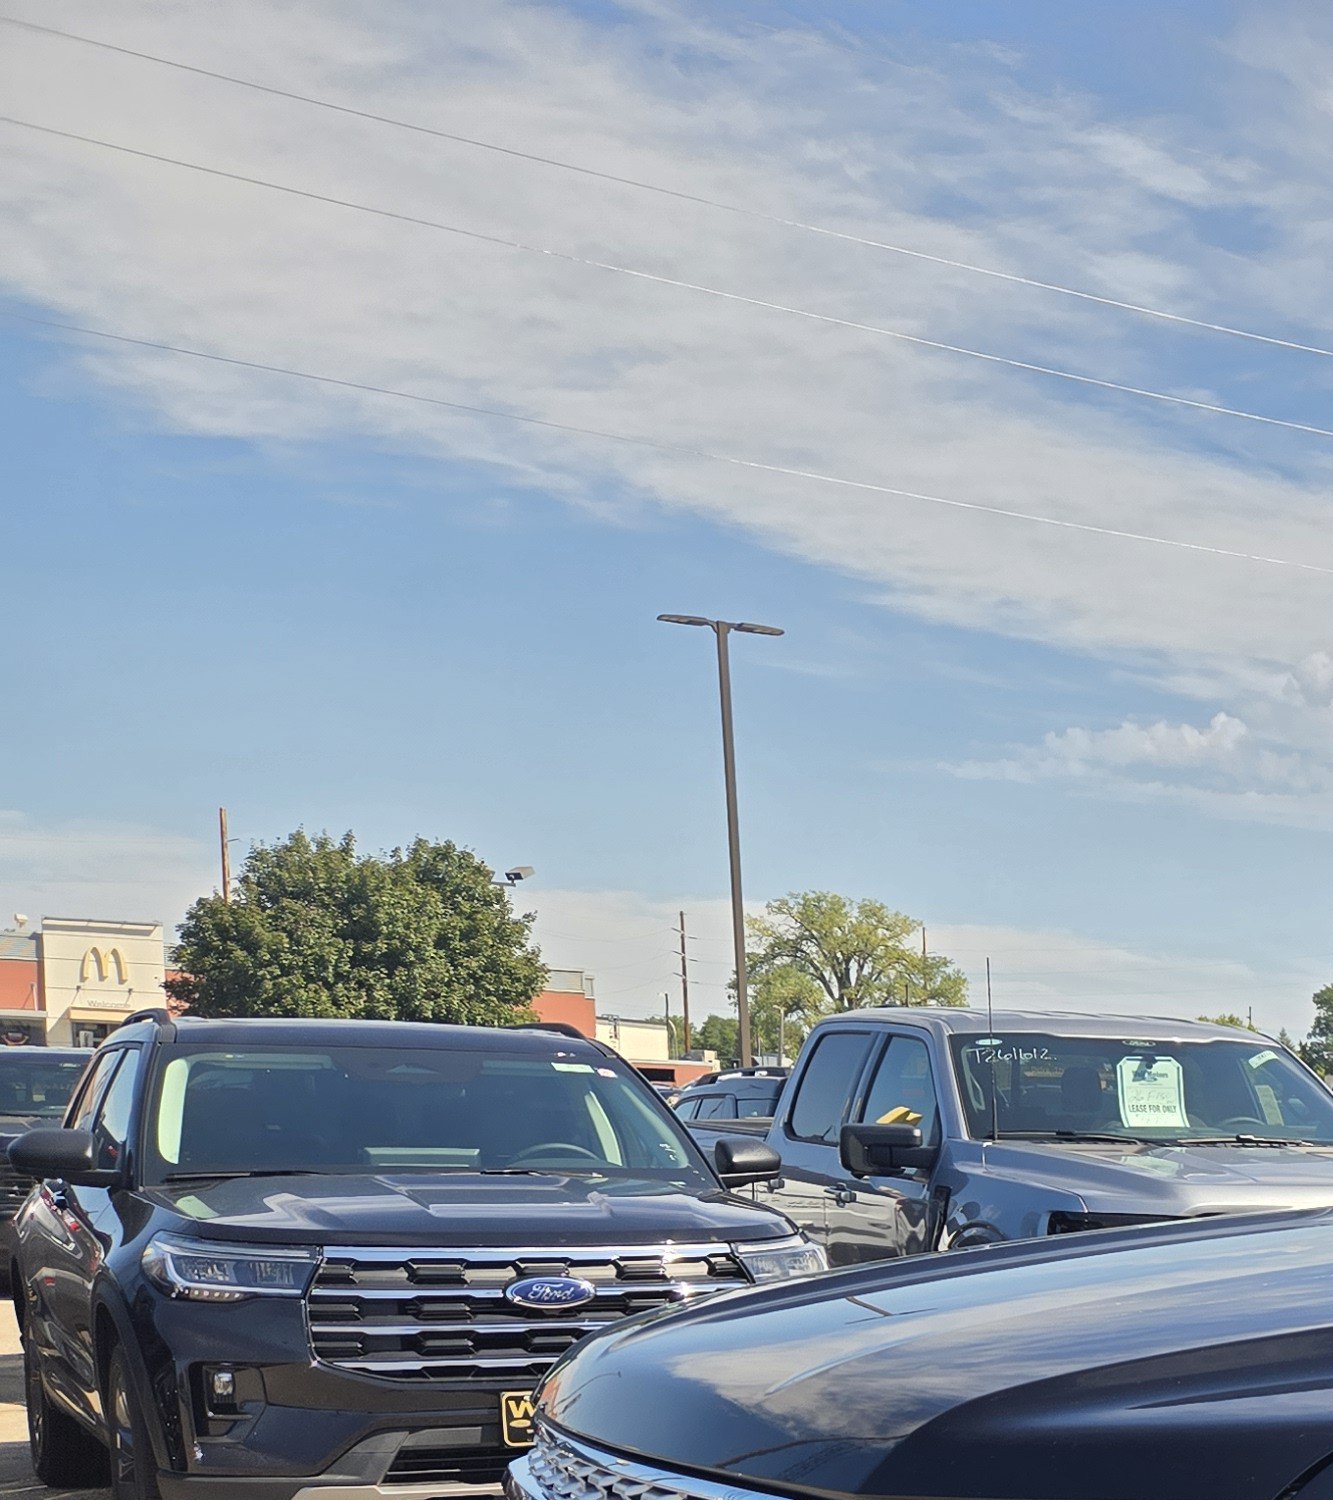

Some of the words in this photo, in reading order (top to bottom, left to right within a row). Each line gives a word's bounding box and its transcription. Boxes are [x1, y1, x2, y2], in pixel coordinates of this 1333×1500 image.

[1128, 1104, 1147, 1113] LEASE
[1148, 1104, 1161, 1113] FOR
[1162, 1104, 1177, 1113] ONLY
[527, 1282, 575, 1301] Ford
